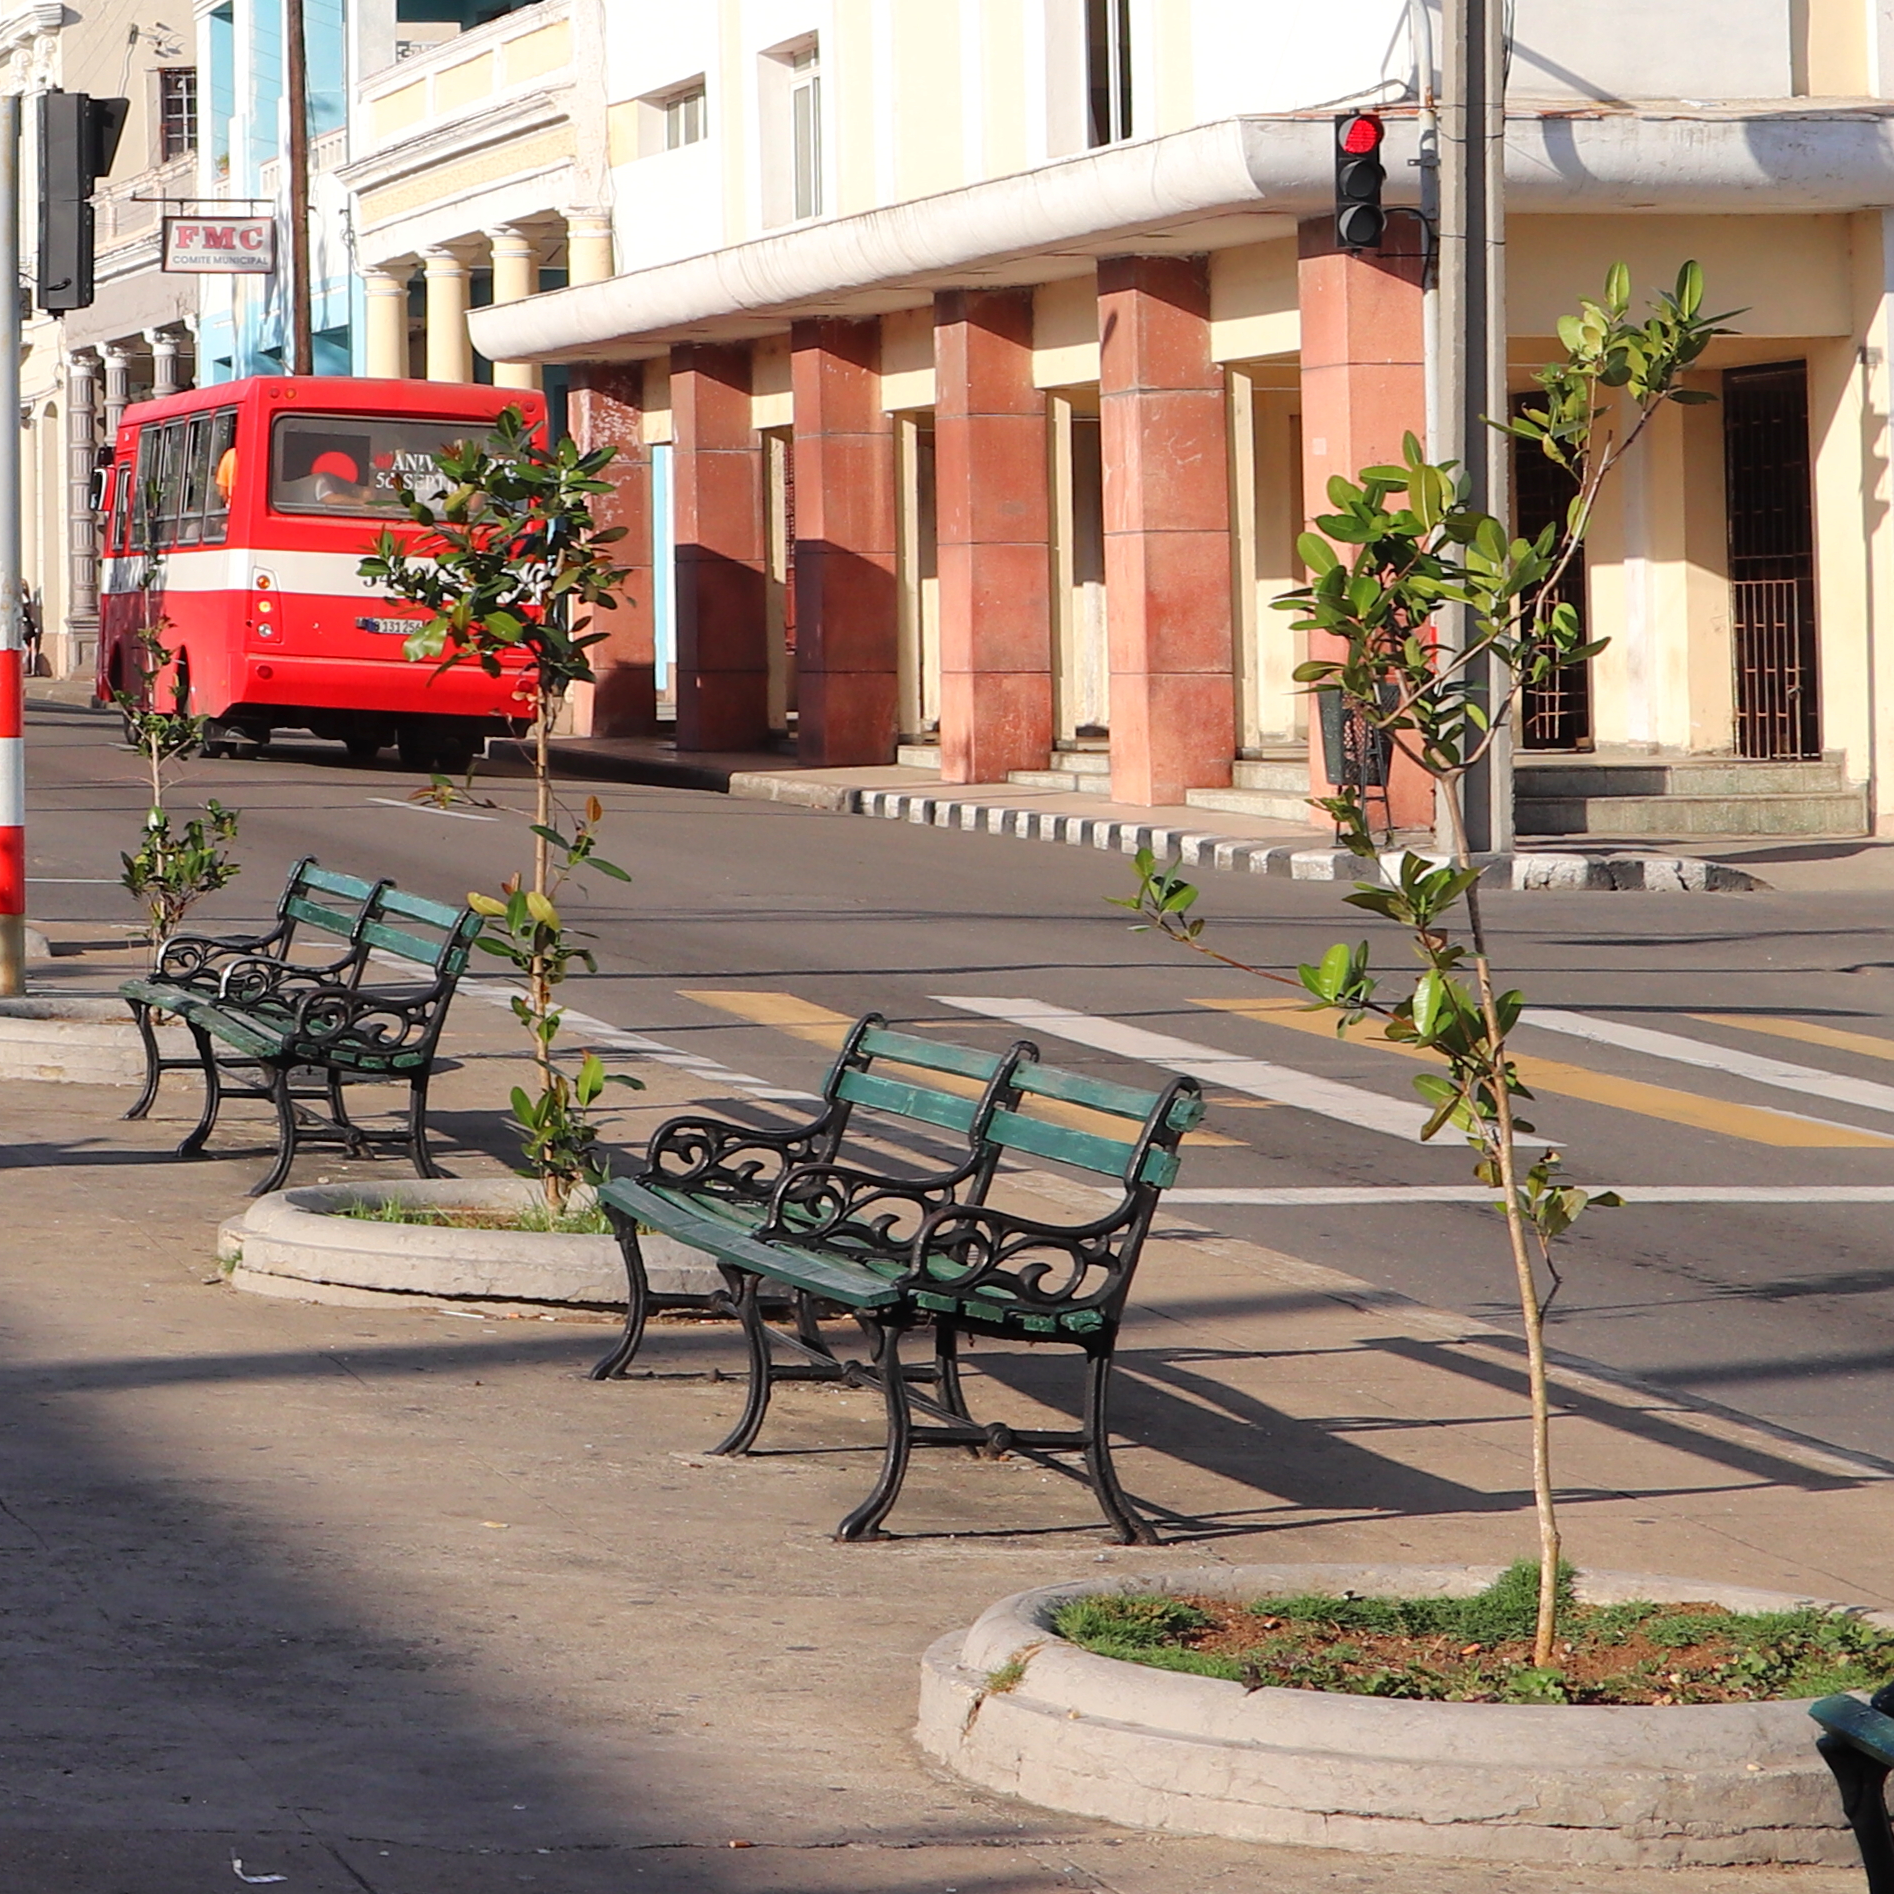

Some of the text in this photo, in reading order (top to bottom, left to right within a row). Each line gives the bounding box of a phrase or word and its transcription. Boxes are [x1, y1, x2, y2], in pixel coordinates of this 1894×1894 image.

[175, 225, 263, 250] FMC
[172, 256, 269, 265] COMITE MUNICIPAL
